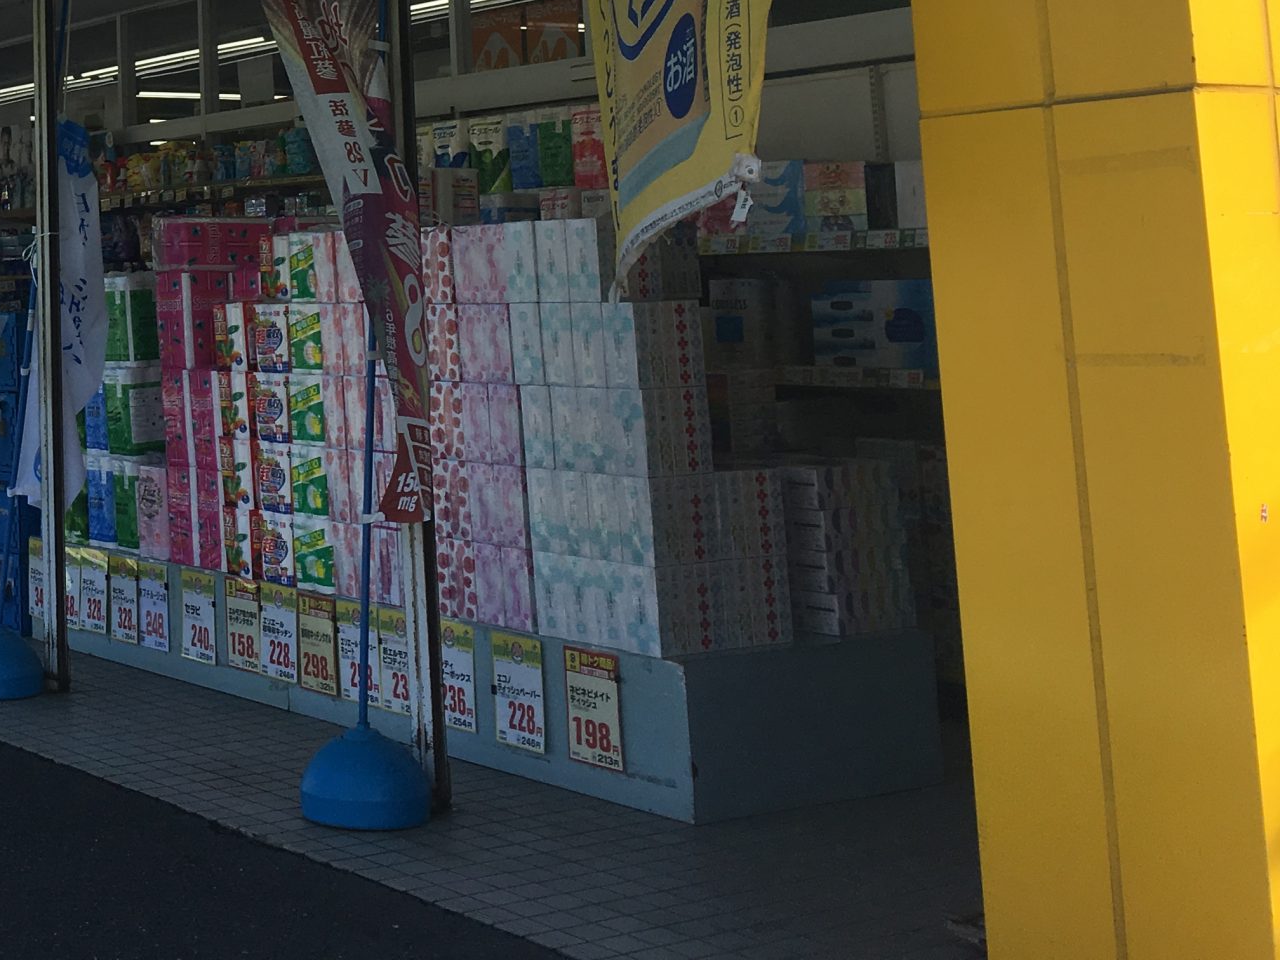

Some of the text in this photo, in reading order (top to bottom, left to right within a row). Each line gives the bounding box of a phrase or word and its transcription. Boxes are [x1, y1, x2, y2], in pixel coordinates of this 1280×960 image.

[269, 638, 296, 671] 228円
[441, 668, 472, 684] ーボックス
[508, 699, 543, 738] 228円
[572, 715, 621, 757] 198円
